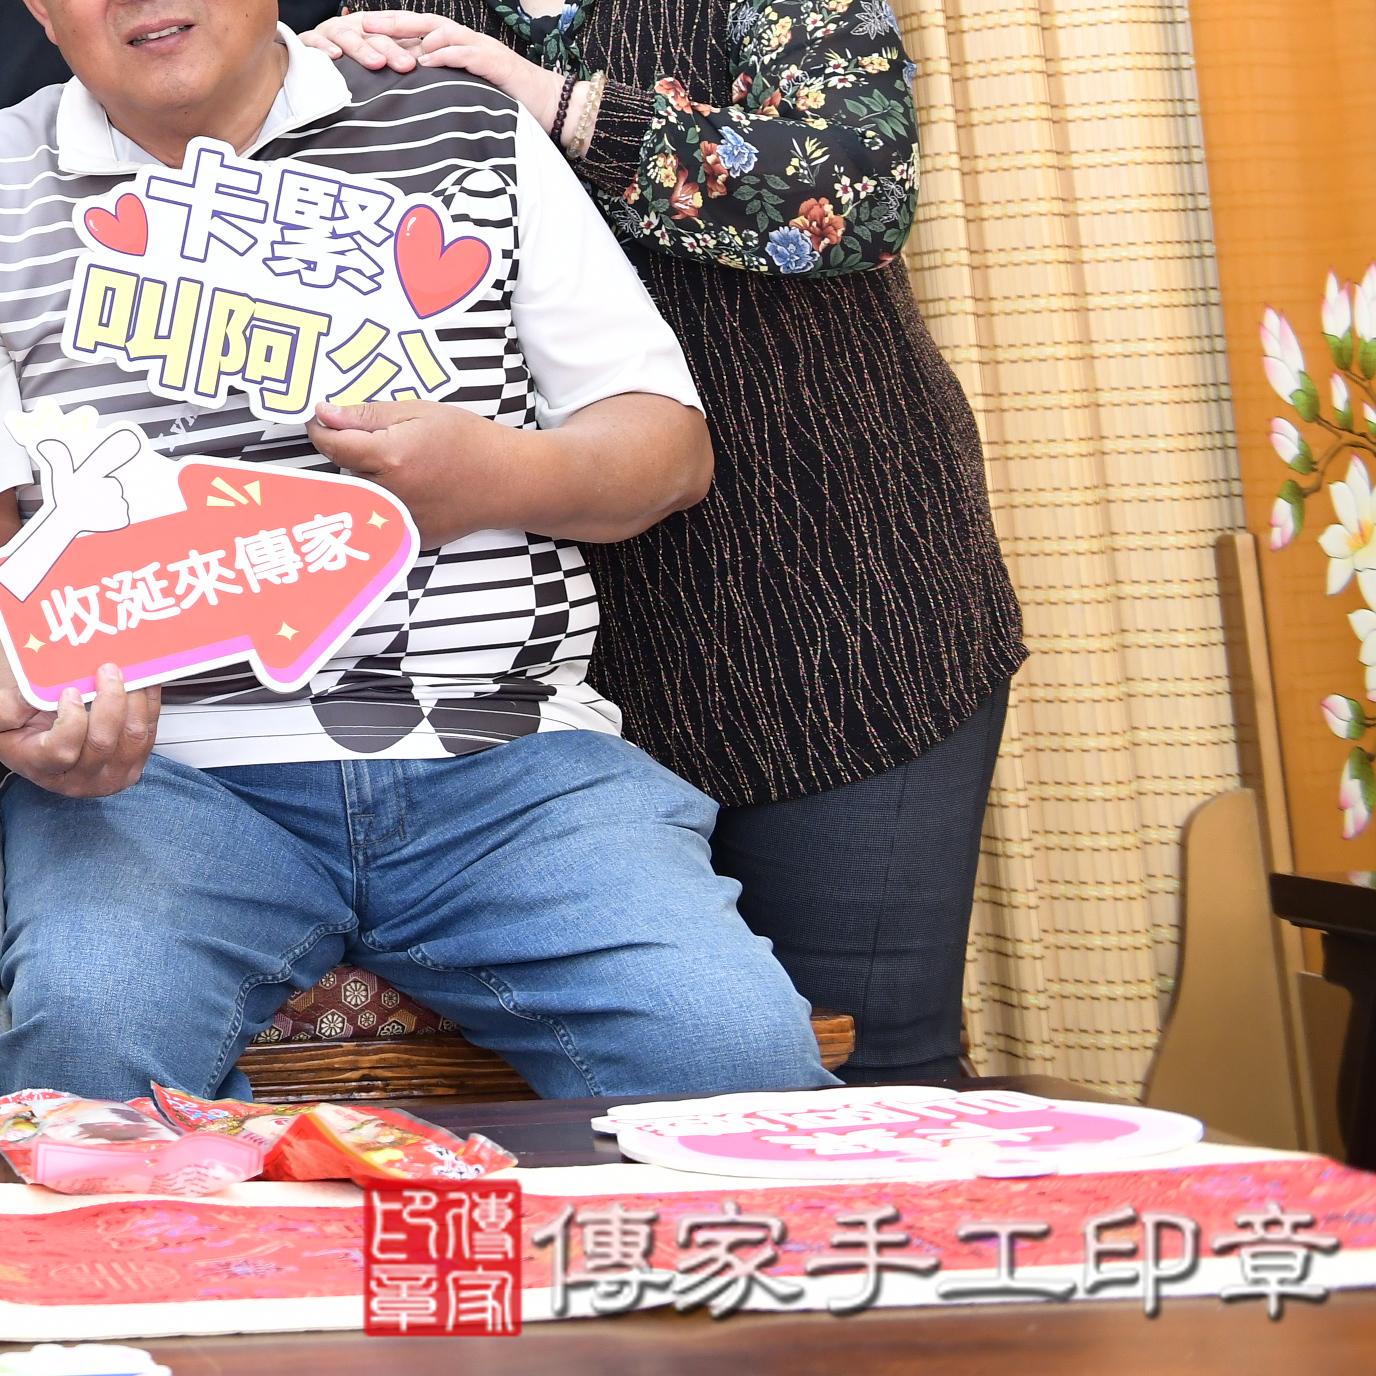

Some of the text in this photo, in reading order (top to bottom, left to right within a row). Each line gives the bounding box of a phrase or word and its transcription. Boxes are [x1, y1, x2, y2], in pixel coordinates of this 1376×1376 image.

[146, 147, 395, 295] 卡緊
[72, 264, 452, 415] 叫阿公
[40, 511, 370, 648] 收涎來傳家
